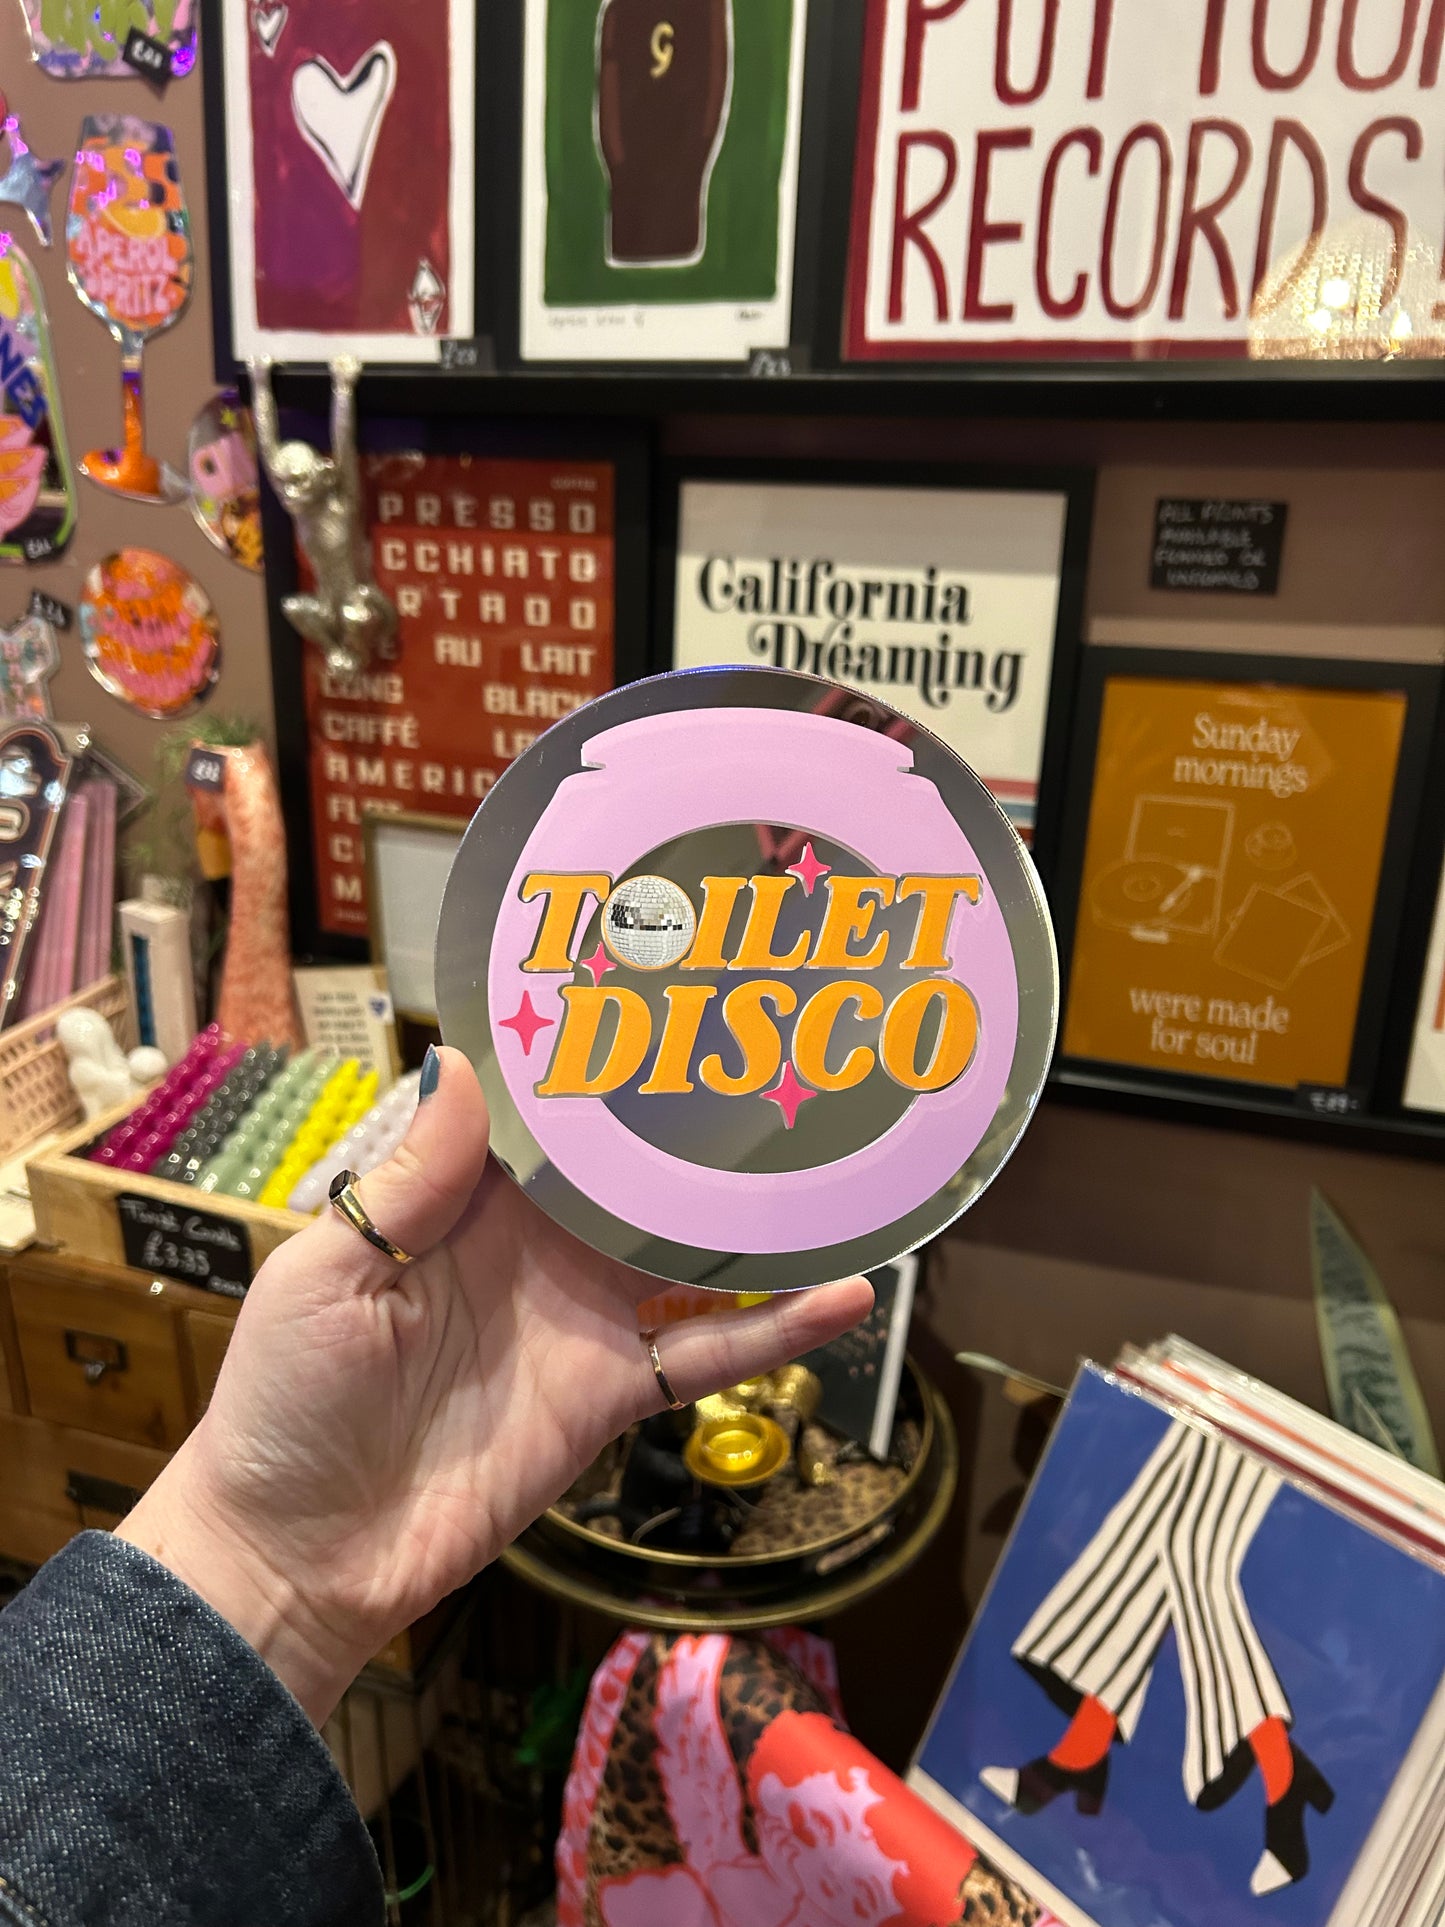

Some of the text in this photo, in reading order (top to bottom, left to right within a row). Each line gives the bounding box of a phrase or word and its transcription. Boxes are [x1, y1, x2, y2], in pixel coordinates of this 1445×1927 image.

[885, 113, 1445, 324] RECORDS
[378, 491, 596, 534] PRESSO
[381, 538, 598, 584] CCHIATO
[397, 585, 597, 631] RTADO
[699, 550, 973, 626] California
[433, 633, 483, 668] AU
[520, 640, 595, 678] LAIT
[747, 620, 1026, 714] Dreaming
[1192, 711, 1301, 762] Sunday
[325, 751, 497, 800] AMERIC
[1173, 751, 1310, 799] mornings
[518, 871, 983, 971] TOILET
[1130, 987, 1290, 1035] were made
[534, 979, 983, 1098] DISCO
[1151, 1015, 1259, 1067] for soul
